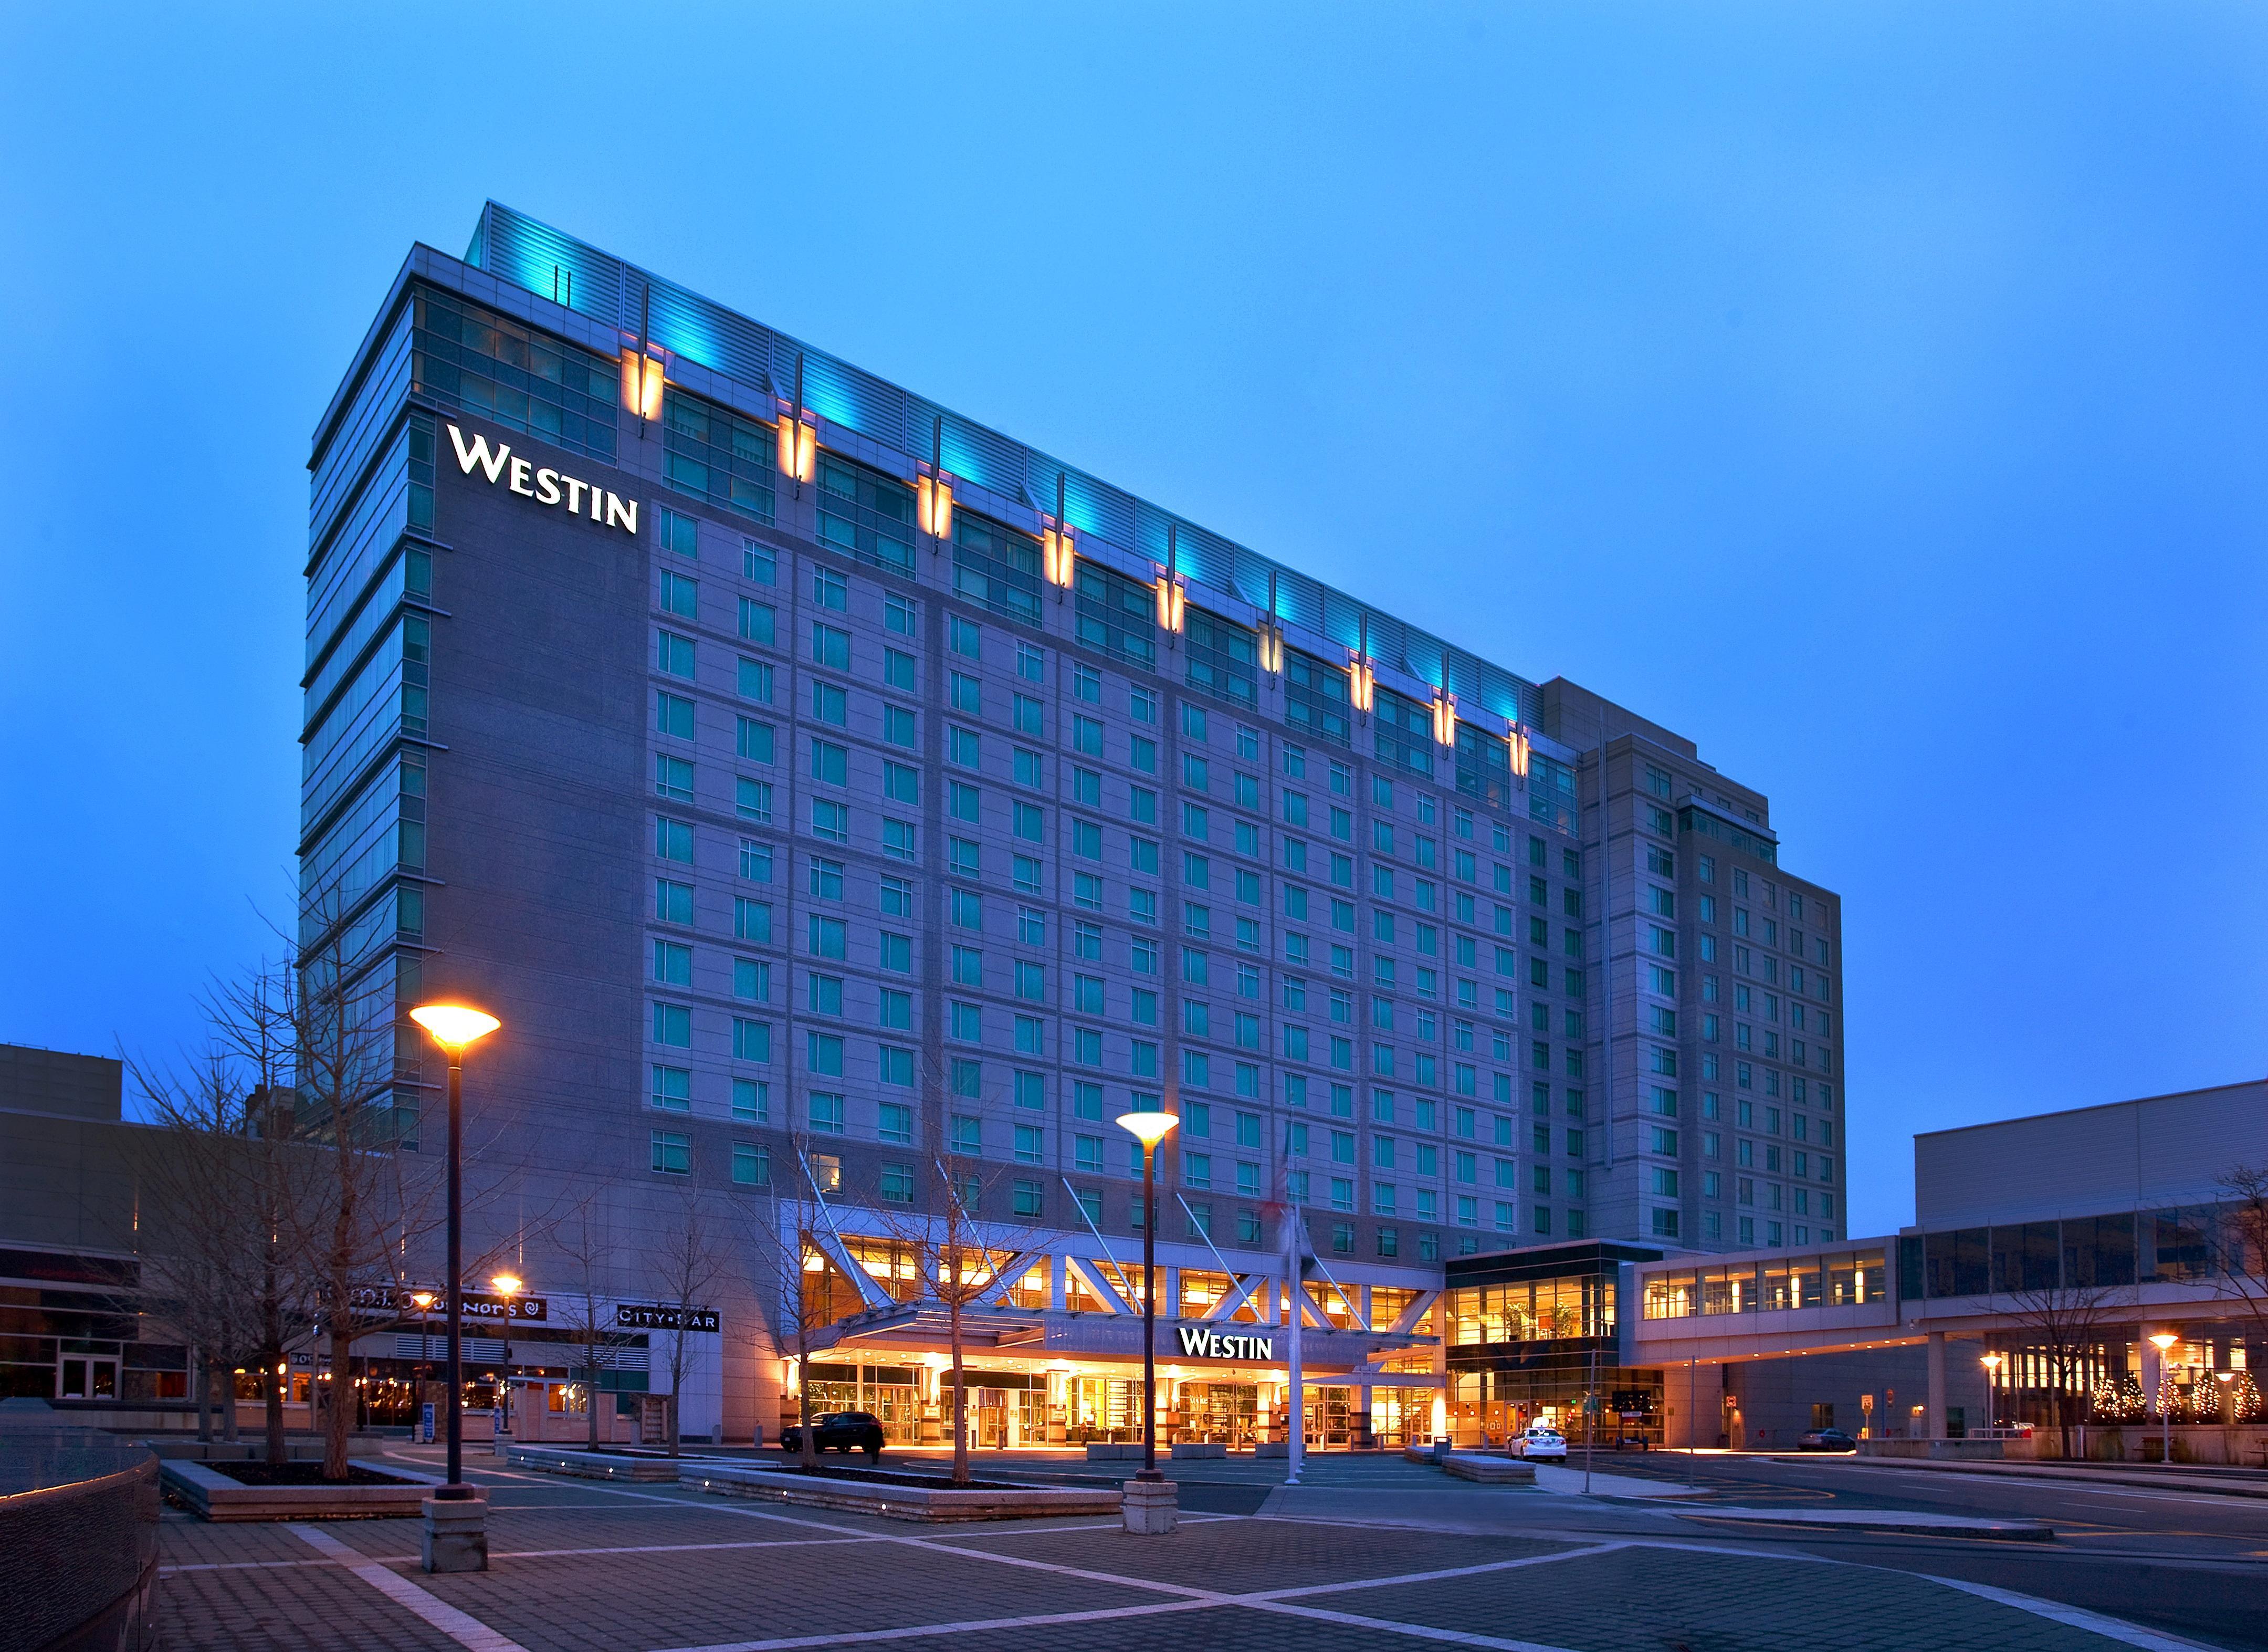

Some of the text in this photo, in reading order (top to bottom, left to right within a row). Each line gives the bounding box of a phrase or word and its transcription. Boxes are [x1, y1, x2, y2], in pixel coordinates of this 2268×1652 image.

[446, 424, 638, 534] WESTIN
[620, 1310, 664, 1323] CITY
[1180, 1327, 1273, 1360] WESTIN
